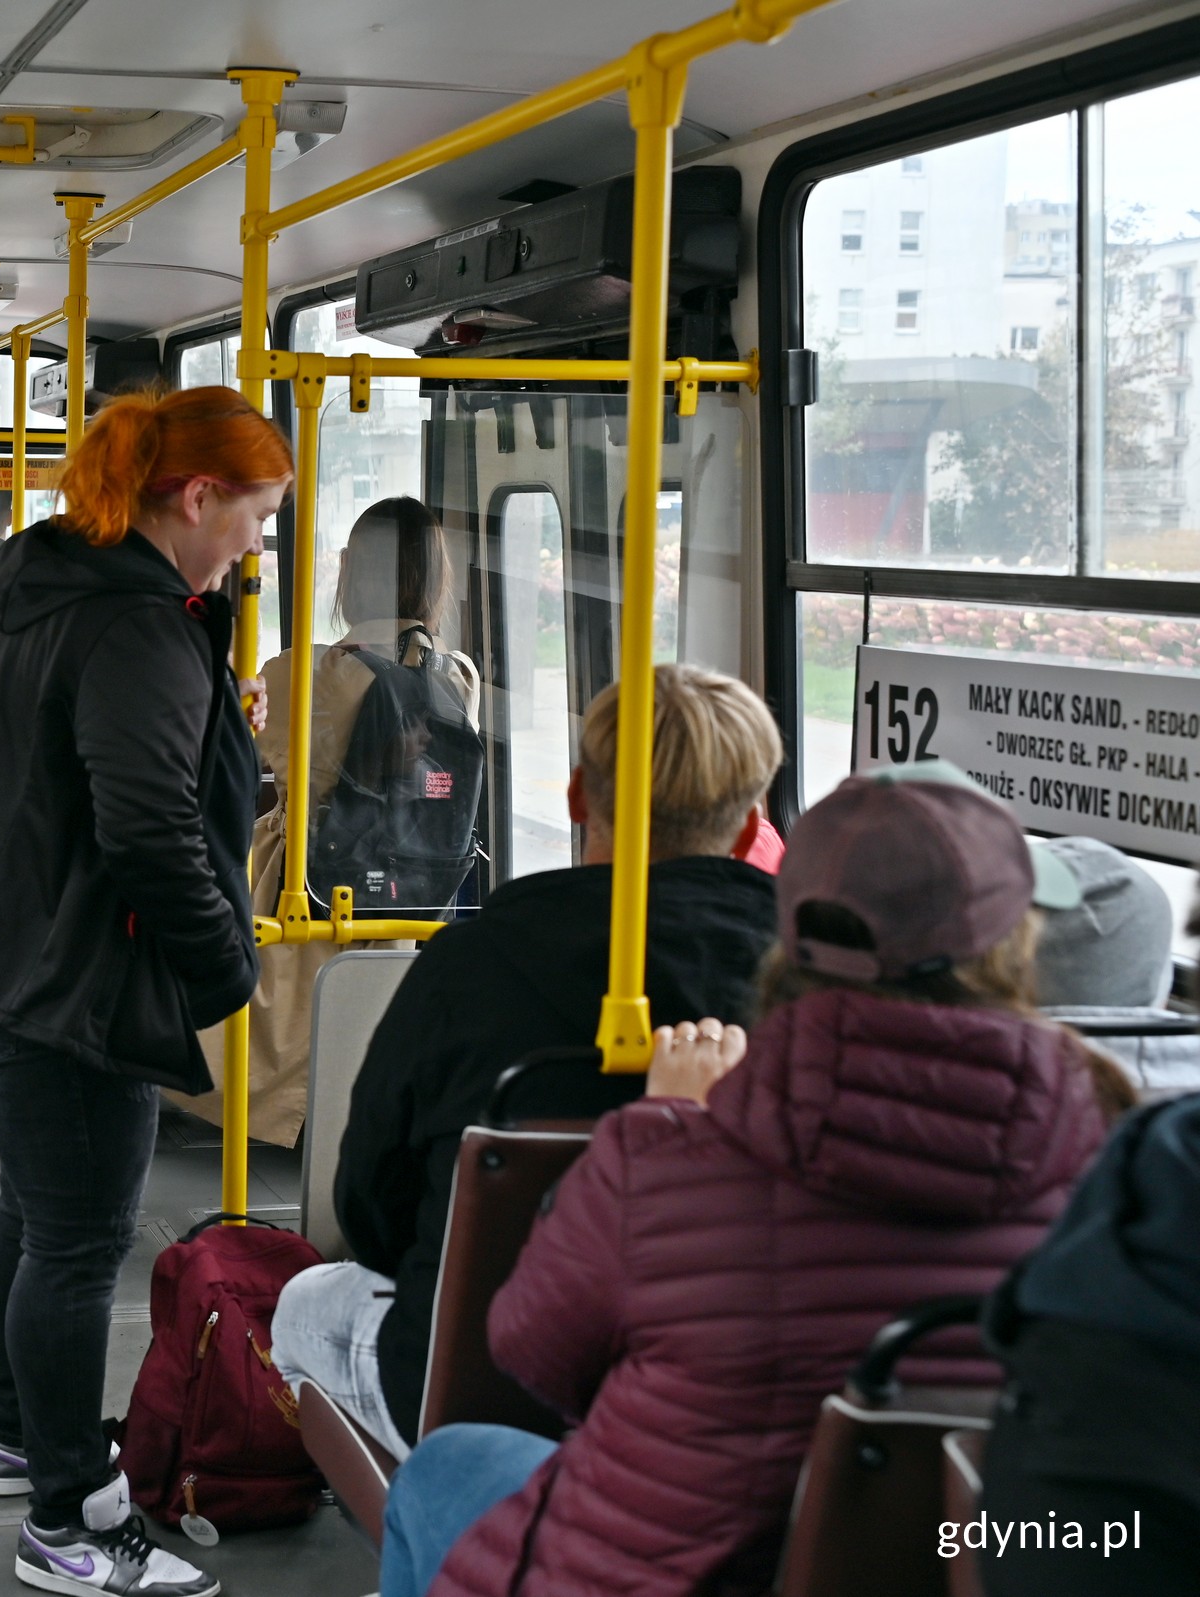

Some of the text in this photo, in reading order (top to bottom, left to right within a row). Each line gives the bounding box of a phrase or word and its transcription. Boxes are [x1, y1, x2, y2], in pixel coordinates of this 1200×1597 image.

[864, 679, 940, 766] 152
[968, 682, 1013, 716] MAŁY
[1017, 688, 1065, 723] KACK
[1070, 693, 1128, 731] SAND.
[1145, 708, 1200, 740] REDŁO
[995, 730, 1065, 764] DWORZEC
[1069, 740, 1092, 768] GŁ.
[1096, 744, 1129, 773] PKP
[1145, 750, 1189, 783] HALA
[1029, 775, 1112, 819] OKSYWIE
[1117, 789, 1200, 835] DICKMA
